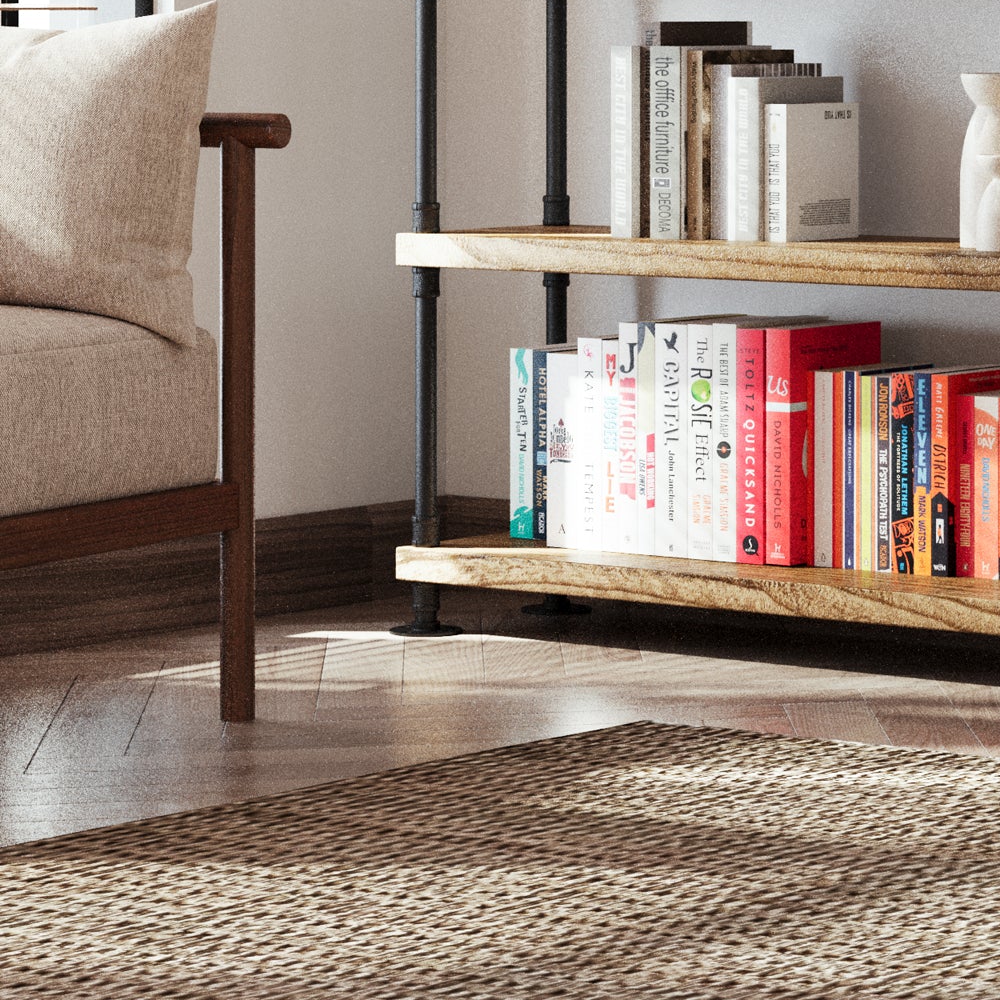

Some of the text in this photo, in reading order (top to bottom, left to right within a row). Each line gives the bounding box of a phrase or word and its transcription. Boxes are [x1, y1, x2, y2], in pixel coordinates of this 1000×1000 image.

[655, 57, 674, 174] the offfice furniture
[658, 193, 670, 232] DECOMA
[538, 368, 546, 447] HOTEL ALPHA
[695, 338, 709, 482] The Effect
[745, 359, 755, 412] TOLTZ
[768, 375, 789, 397] Us
[879, 383, 888, 440] JON RONSON
[517, 387, 528, 452] STARTER TEN
[917, 379, 928, 484] ELEVEN
[976, 423, 996, 438] ONE
[977, 438, 995, 450] DAY
[744, 419, 755, 527] QUICKSAND
[773, 421, 782, 529] DAVID NICHOLLS
[879, 449, 888, 540] THE PSYCHOPATH TEST
[896, 474, 901, 482] OF
[933, 444, 946, 489] OSTRICH
